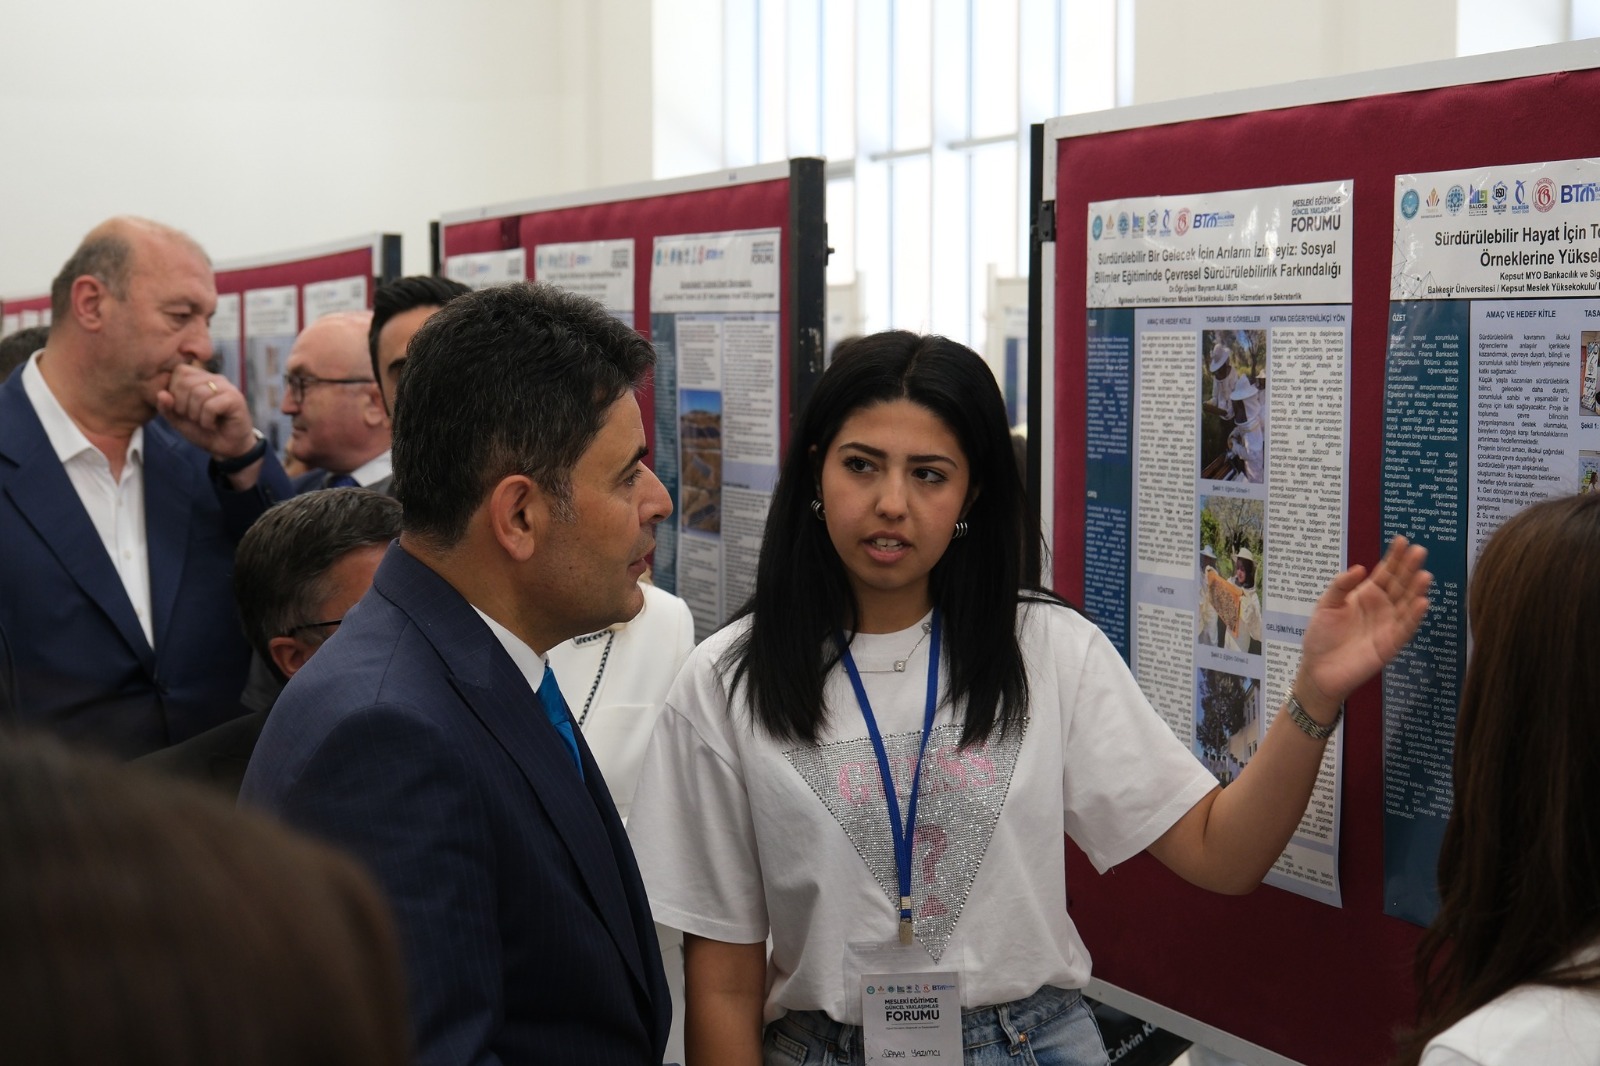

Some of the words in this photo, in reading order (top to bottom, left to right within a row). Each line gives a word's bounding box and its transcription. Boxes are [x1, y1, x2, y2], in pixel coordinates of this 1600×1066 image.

[1291, 214, 1341, 233] FORUMU
[1435, 229, 1519, 246] Sürdürülebilir
[1523, 227, 1560, 245] Hayat
[1563, 221, 1586, 244] İçin
[1098, 249, 1146, 265] Sürdürülebilir
[1149, 250, 1160, 262] Bir
[1162, 248, 1197, 262] Gelecek
[1198, 244, 1214, 263] İçin
[1216, 246, 1251, 260] Arıların
[1301, 241, 1336, 258] Sosyal
[1480, 249, 1555, 267] Örneklerine
[1094, 271, 1120, 284] Bilimler
[1122, 269, 1162, 285] Eğitiminde
[1165, 267, 1201, 283] Çevresel
[1203, 263, 1277, 280] Sürdürülebilirlik
[1281, 261, 1341, 279] Farkındalığı
[1500, 271, 1524, 283] Kepsut
[1526, 271, 1541, 280] MYO
[1543, 270, 1578, 280] Bankacılık
[1456, 283, 1496, 293] Üniversitesi
[1501, 283, 1525, 294] Kepsut
[1526, 283, 1550, 292] Meslek
[1240, 293, 1265, 301] Hizmetleri
[1274, 293, 1301, 301] Sekreterlik
[1392, 313, 1406, 321] ÖZET
[1486, 311, 1504, 319] AMAÇ
[1516, 310, 1537, 318] HEDEF
[1538, 309, 1556, 318] KİTLE
[885, 997, 909, 1005] MESLEKİ
[910, 996, 938, 1004] EĞİTİMDE
[886, 1010, 940, 1021] FORUMU
[1107, 1033, 1144, 1063] Calvin
